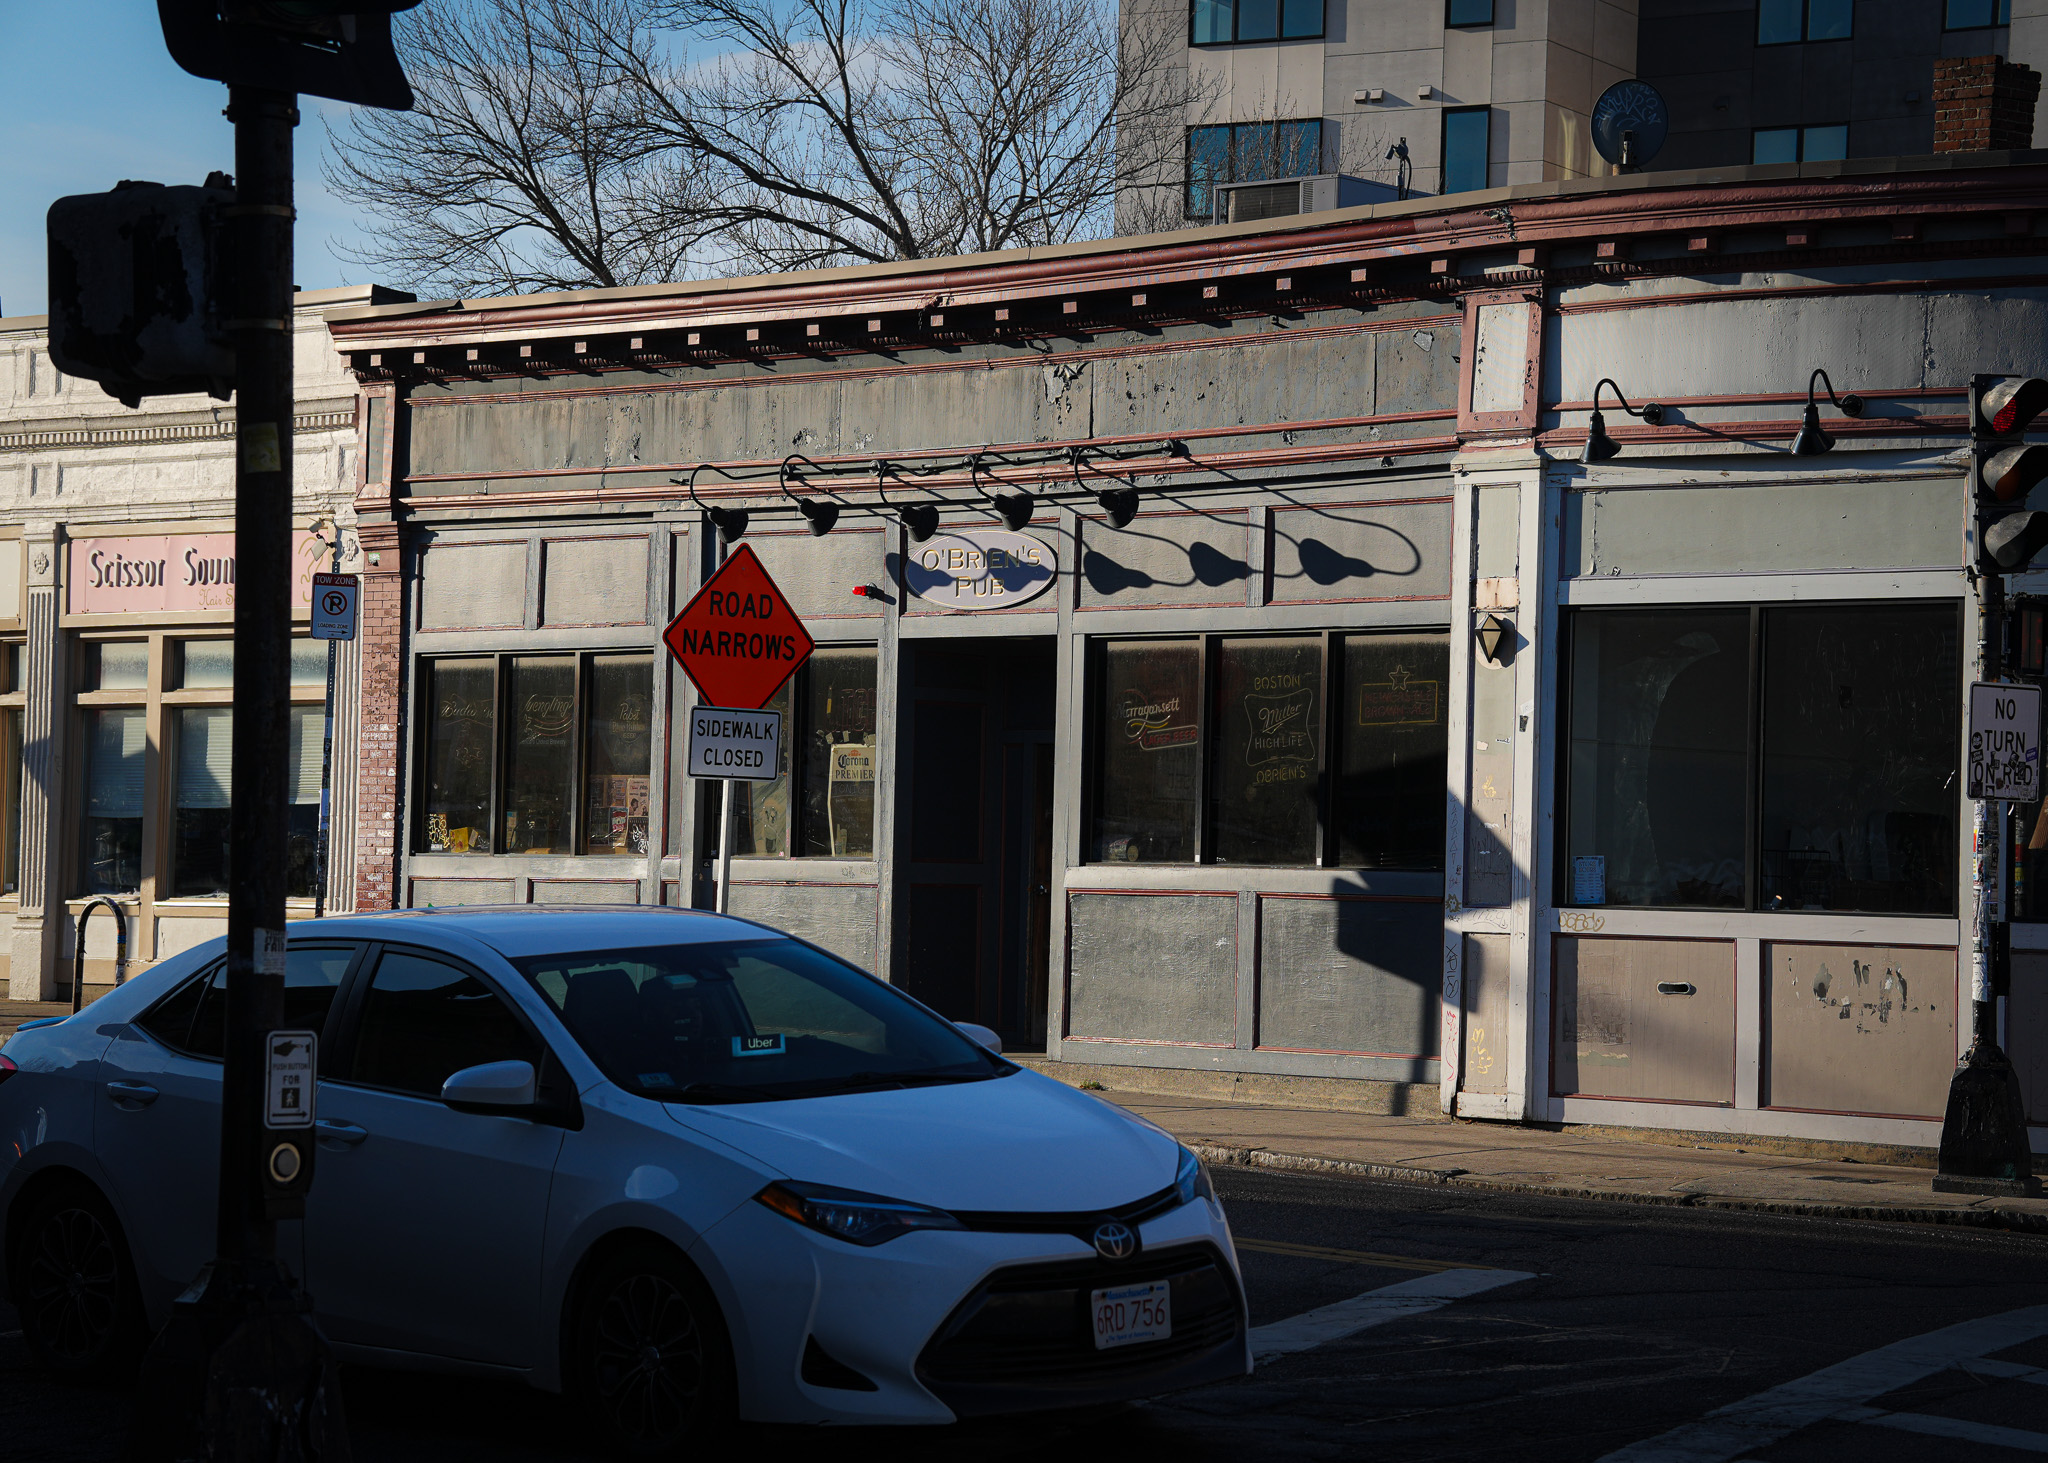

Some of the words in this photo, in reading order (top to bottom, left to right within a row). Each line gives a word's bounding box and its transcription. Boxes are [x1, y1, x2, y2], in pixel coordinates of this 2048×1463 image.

[89, 549, 165, 587] Scissor
[183, 547, 235, 586] Soun
[922, 545, 1041, 571] O'BRIEN'S
[316, 576, 332, 584] TOW
[335, 577, 355, 585] ZONE
[955, 576, 1004, 597] PUB
[198, 588, 222, 606] Hair
[710, 590, 773, 619] ROAD
[682, 628, 795, 661] NARROWS
[1254, 674, 1300, 691] BOSTON
[620, 702, 641, 720] Pabst
[1112, 697, 1180, 720] Narragansett
[1258, 703, 1302, 729] Miller
[1995, 698, 2016, 720] NO
[697, 719, 774, 740] SIDEWALK
[1144, 733, 1170, 746] LAGER
[1173, 729, 1198, 742] BEER
[1255, 736, 1280, 749] HIGH
[1282, 735, 1303, 748] LIFE
[1984, 729, 2025, 753] TURN
[704, 748, 763, 767] CLOSED
[837, 753, 869, 769] Corona
[835, 769, 874, 780] PREMIER
[1974, 762, 1995, 784] ON
[2003, 763, 2033, 786] RED
[748, 1037, 773, 1049] Uber
[283, 1075, 300, 1084] FOR
[1097, 1303, 1125, 1335] 6RD
[1131, 1297, 1165, 1329] 756
